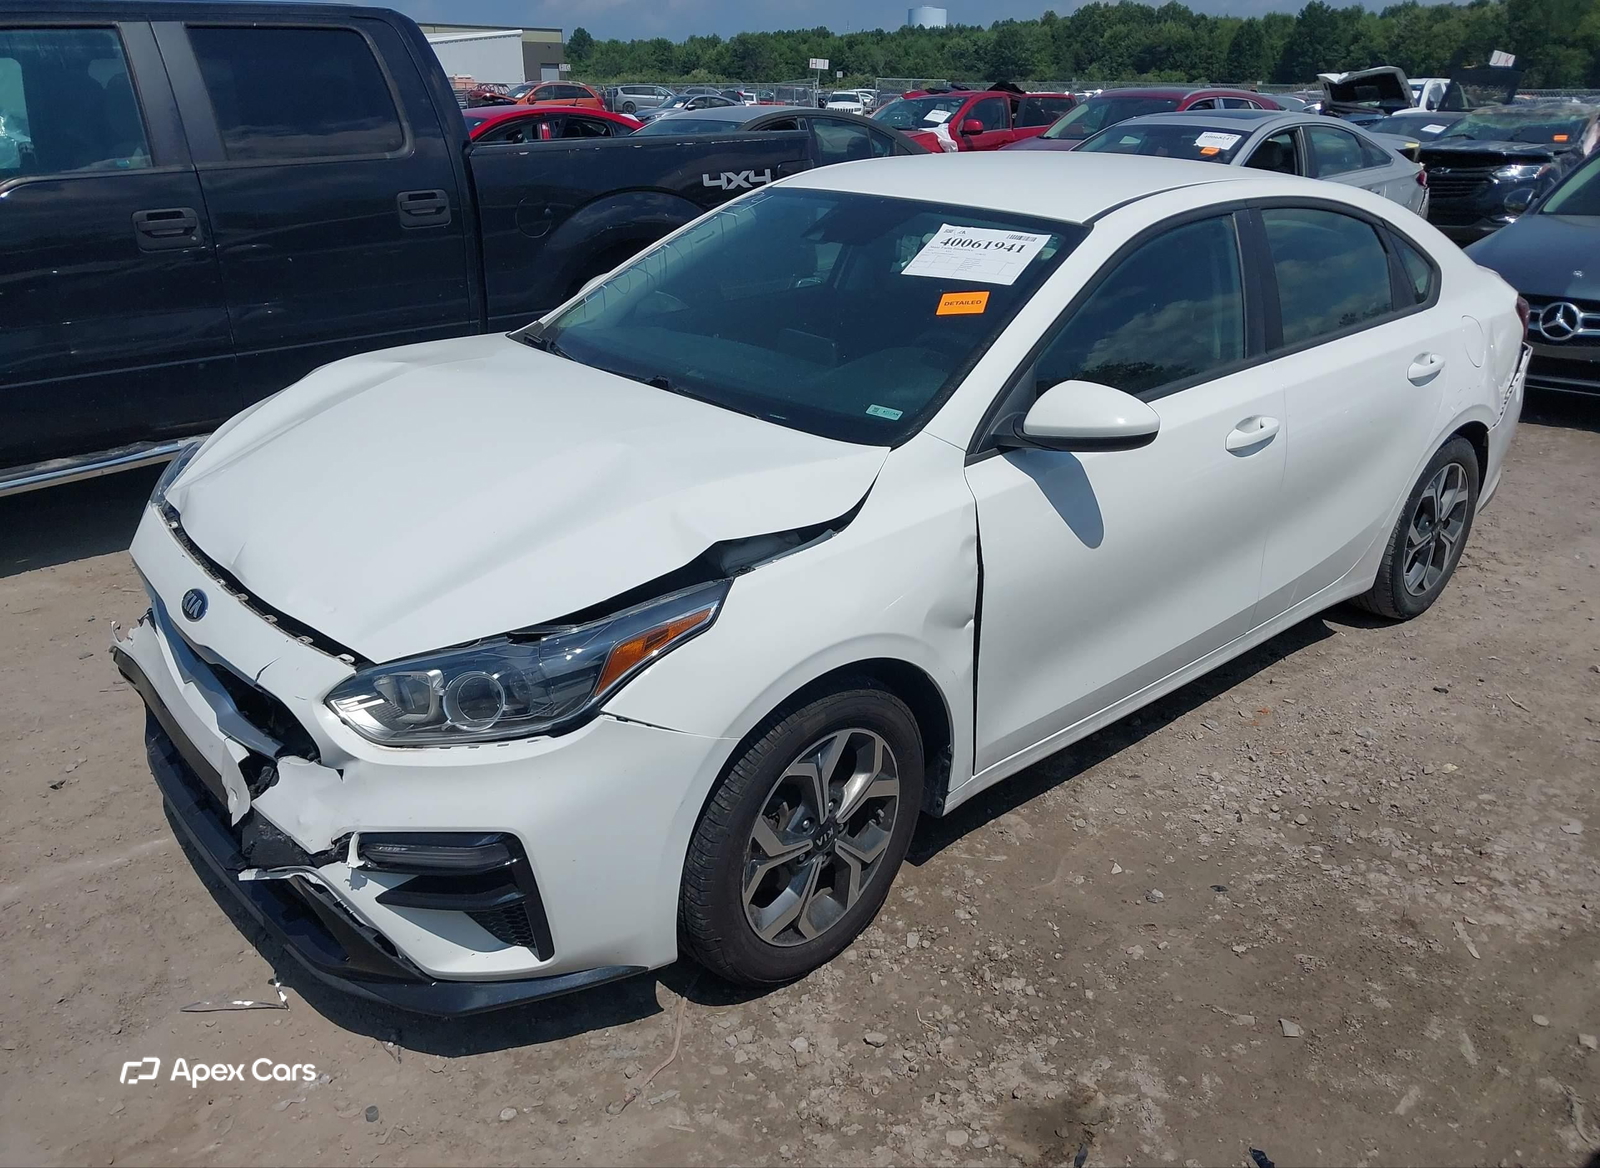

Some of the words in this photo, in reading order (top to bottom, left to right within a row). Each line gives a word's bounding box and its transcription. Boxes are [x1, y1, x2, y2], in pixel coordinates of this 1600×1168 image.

[702, 169, 772, 190] 4X4
[940, 236, 1026, 253] 40061941
[183, 590, 203, 618] KIA
[816, 827, 834, 846] KIA
